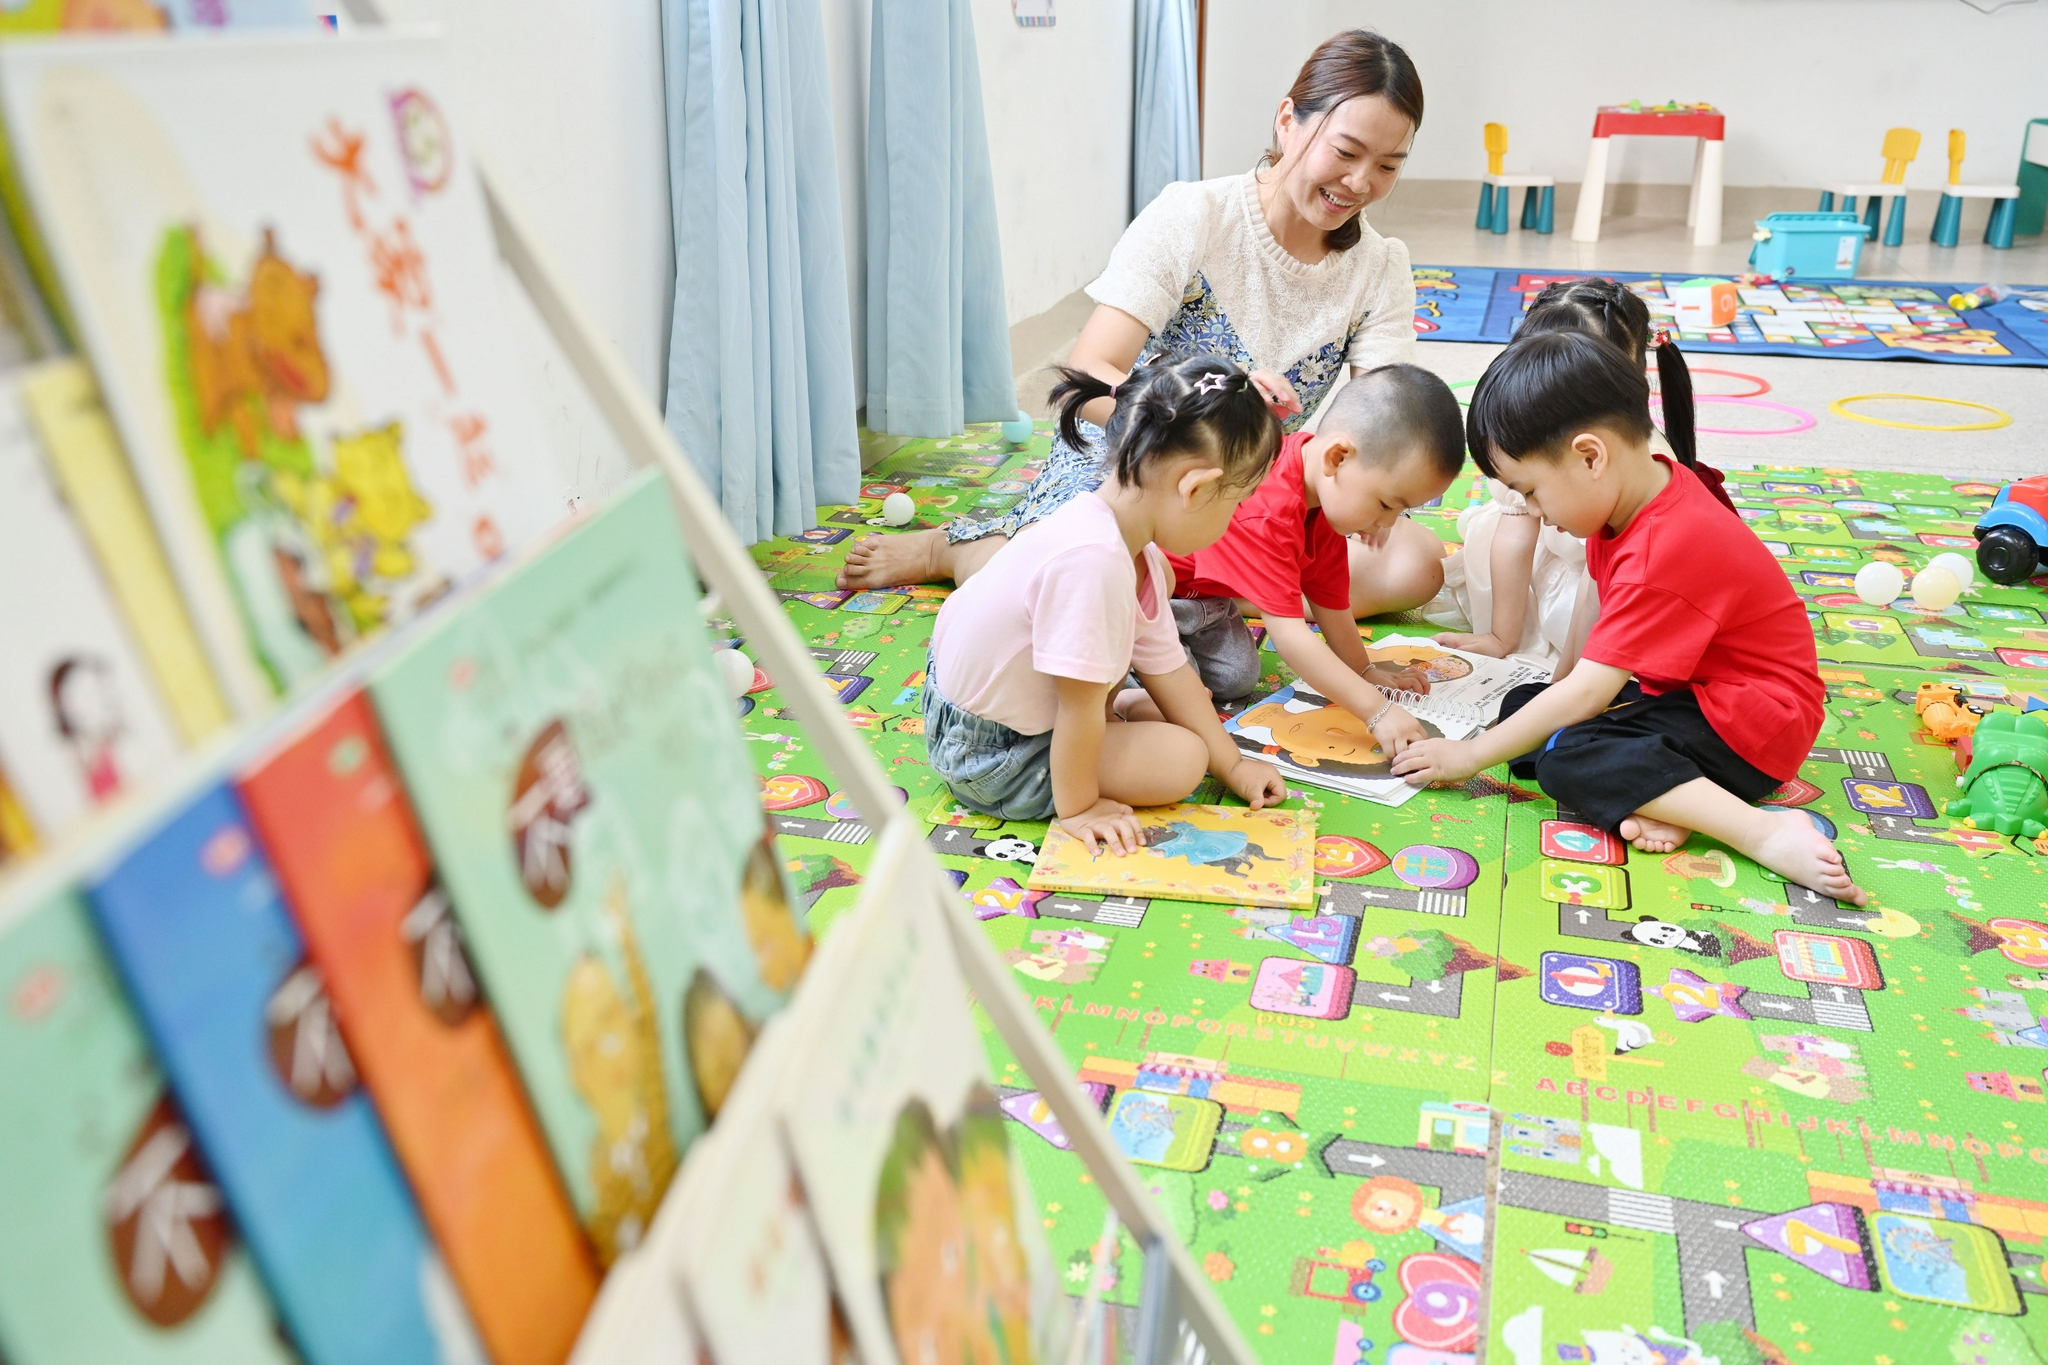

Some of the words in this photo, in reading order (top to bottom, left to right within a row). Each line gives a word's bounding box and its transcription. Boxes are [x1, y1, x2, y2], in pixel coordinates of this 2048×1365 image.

[1849, 620, 1879, 631] 5
[1854, 784, 1908, 808] 12
[1552, 834, 1601, 852] 4
[1949, 829, 2004, 851] 11
[1550, 873, 1602, 893] 3
[972, 889, 1024, 910] 2
[1287, 916, 1343, 948] 15
[1550, 971, 1607, 987] 1
[1661, 983, 1719, 1009] 2
[1024, 993, 1477, 1071] KLMNOPQRSTUVWXYZ
[1256, 1012, 1317, 1030] end
[1240, 1128, 1307, 1163] 8
[1786, 1218, 1861, 1255] 7
